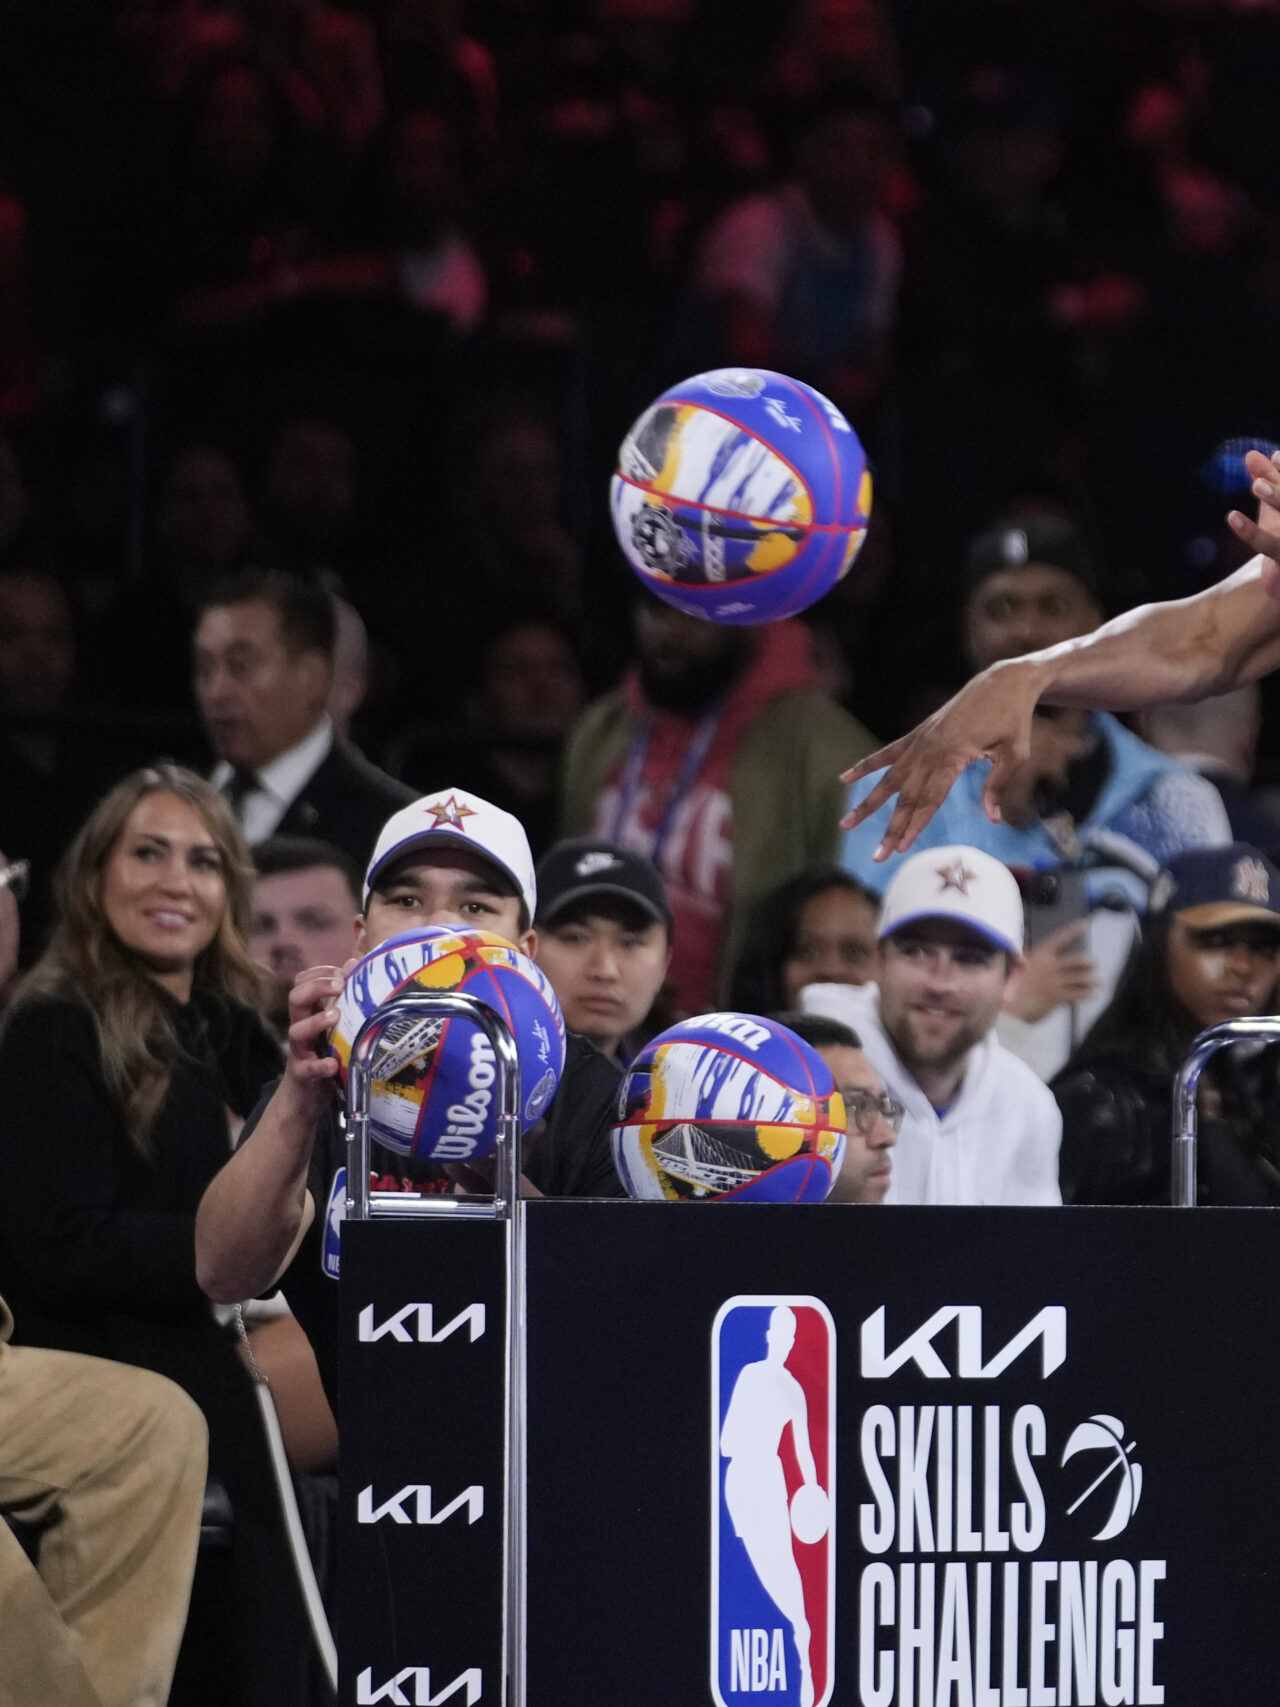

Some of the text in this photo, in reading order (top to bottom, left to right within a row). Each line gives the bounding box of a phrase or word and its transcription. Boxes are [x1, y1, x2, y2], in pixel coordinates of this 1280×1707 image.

[430, 1032, 498, 1159] Wilson
[358, 1303, 485, 1343] KIA
[859, 1305, 1066, 1378] KIA
[357, 1485, 484, 1524] KIA
[860, 1404, 1047, 1553] SKILLS
[730, 1628, 787, 1692] NBA
[859, 1559, 1167, 1707] CHALLENGE
